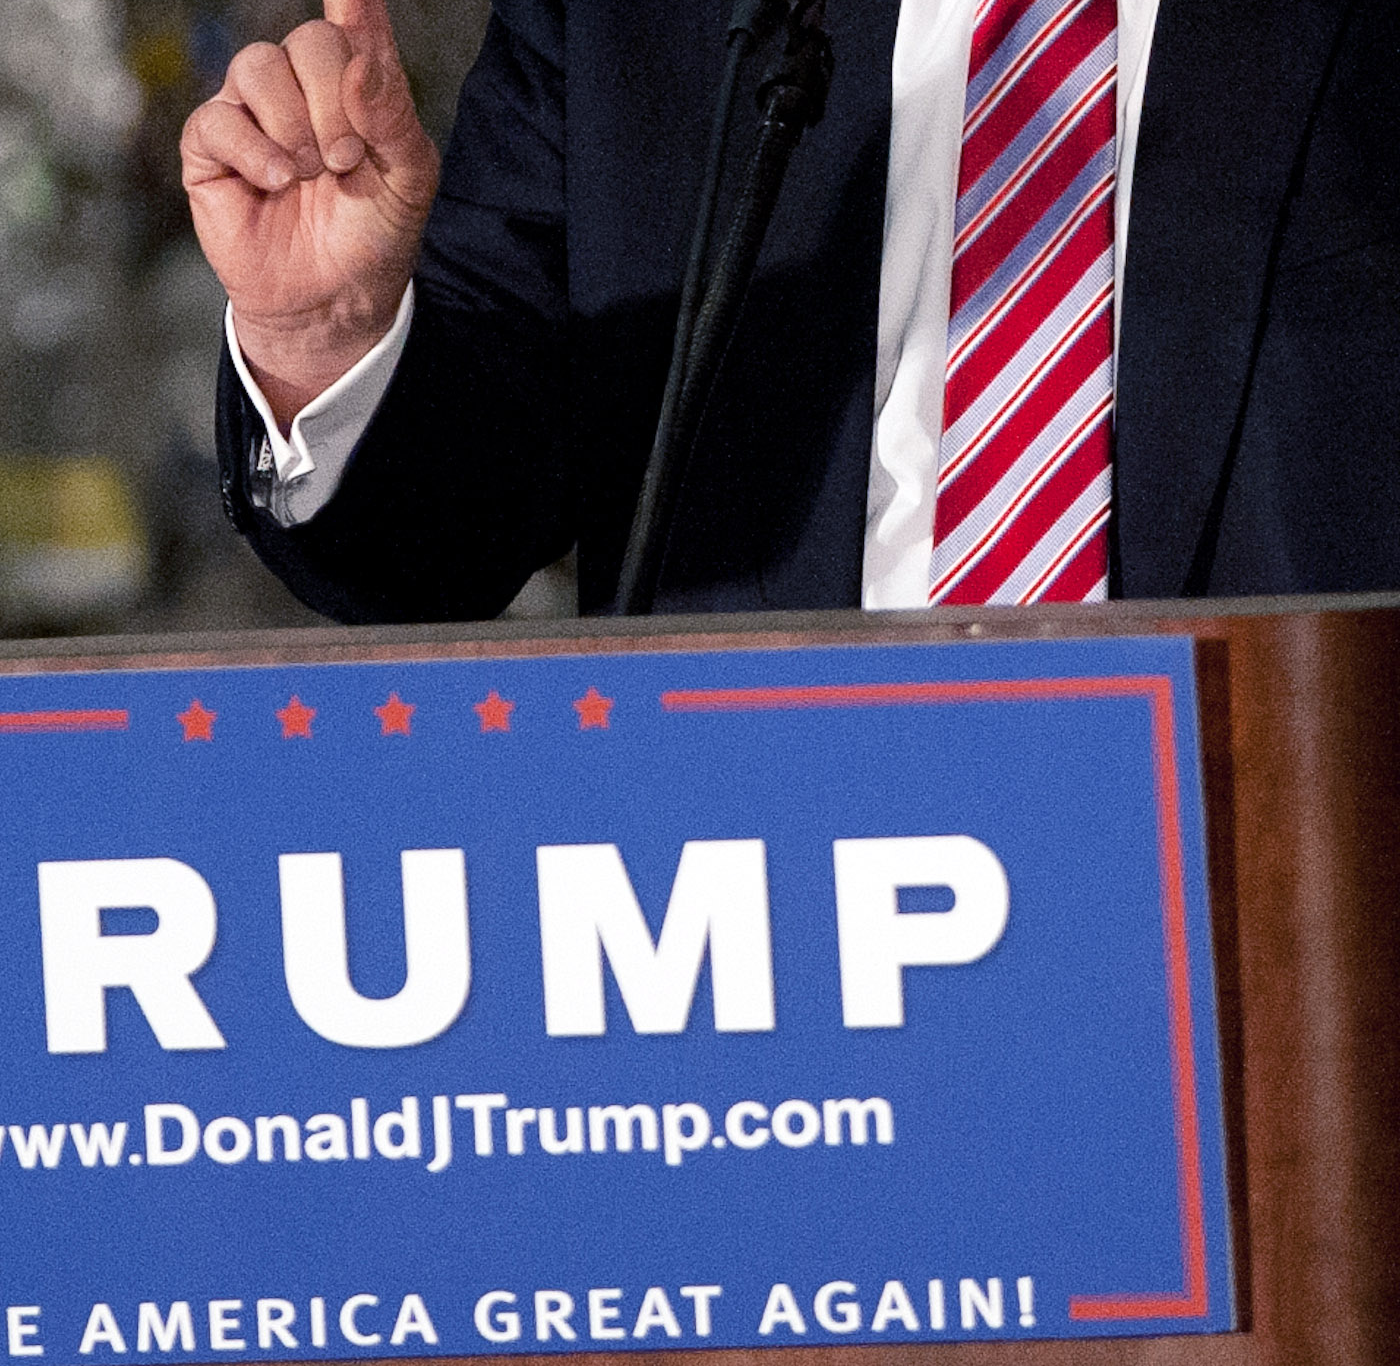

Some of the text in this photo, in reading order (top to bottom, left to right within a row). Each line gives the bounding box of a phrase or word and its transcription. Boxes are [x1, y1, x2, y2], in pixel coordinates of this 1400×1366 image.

[78, 1289, 440, 1356] AMERICA
[472, 1282, 723, 1344] GREAT
[757, 1275, 1037, 1336] AGAIN!
